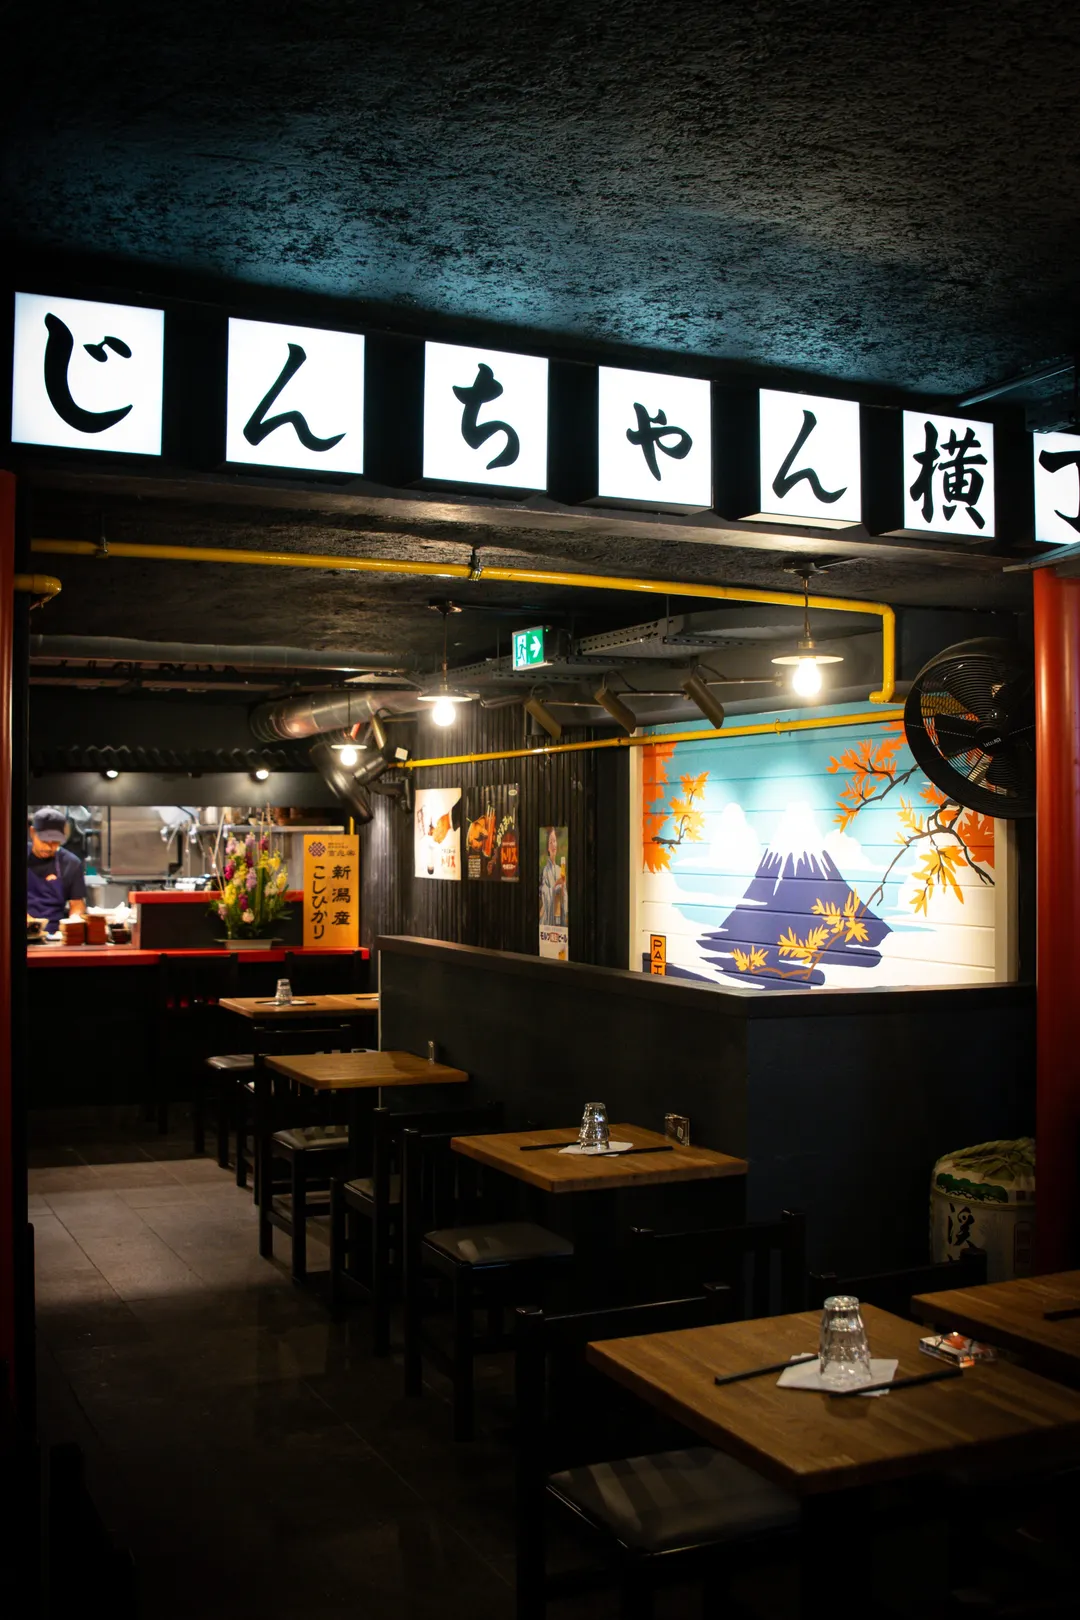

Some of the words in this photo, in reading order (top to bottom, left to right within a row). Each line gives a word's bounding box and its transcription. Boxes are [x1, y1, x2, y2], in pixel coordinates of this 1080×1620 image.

[311, 865, 328, 940] こしひかり
[331, 865, 352, 926] 新潟産
